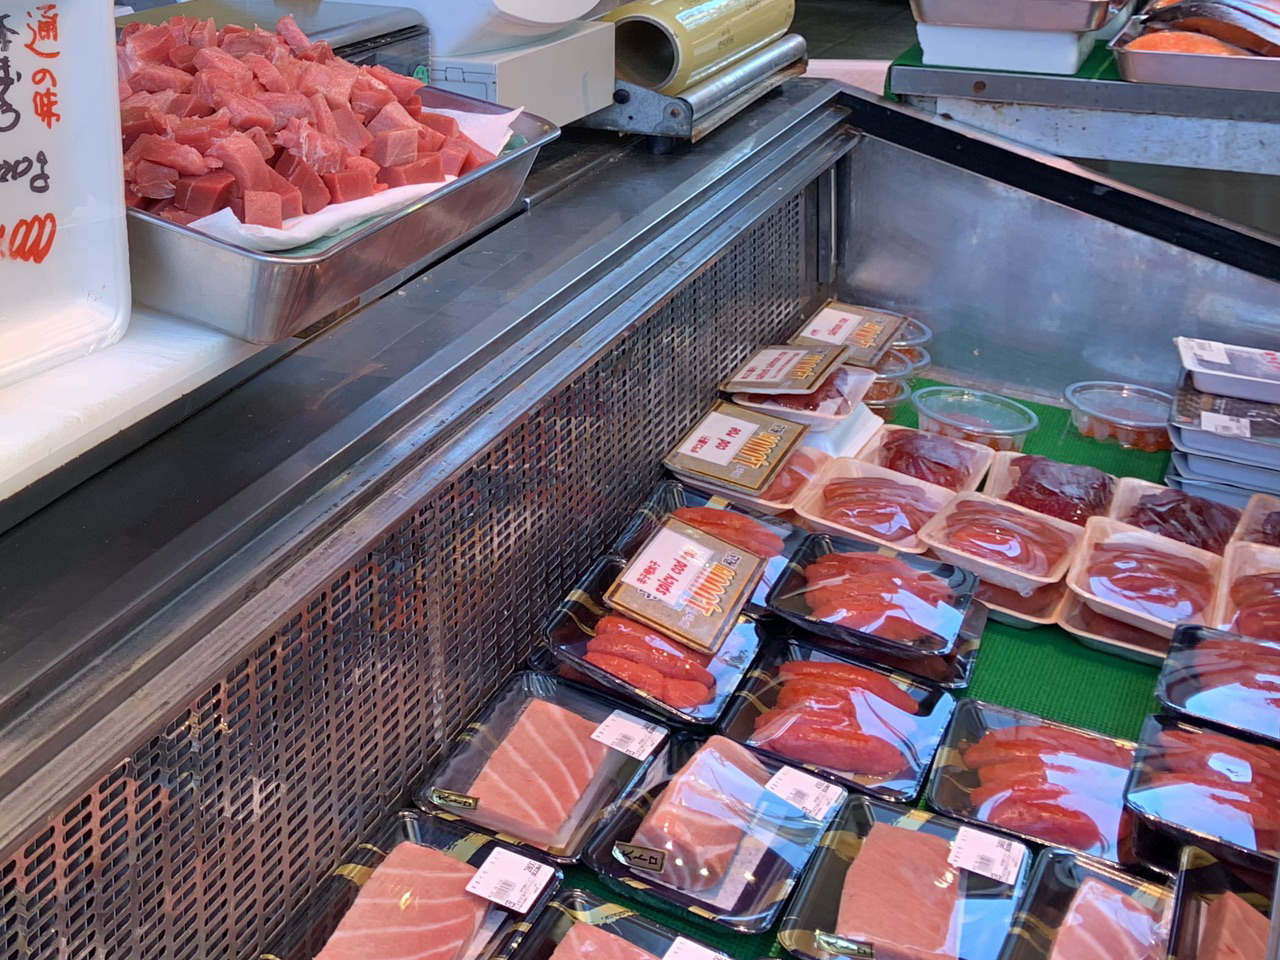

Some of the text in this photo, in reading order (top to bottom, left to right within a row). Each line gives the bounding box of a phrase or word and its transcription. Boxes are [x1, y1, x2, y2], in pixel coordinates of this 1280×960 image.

[714, 426, 743, 452] cod roe
[655, 572, 680, 597] spicy
[670, 557, 690, 576] cod
[435, 794, 472, 808] 大トロ
[621, 848, 659, 867] 大トロ
